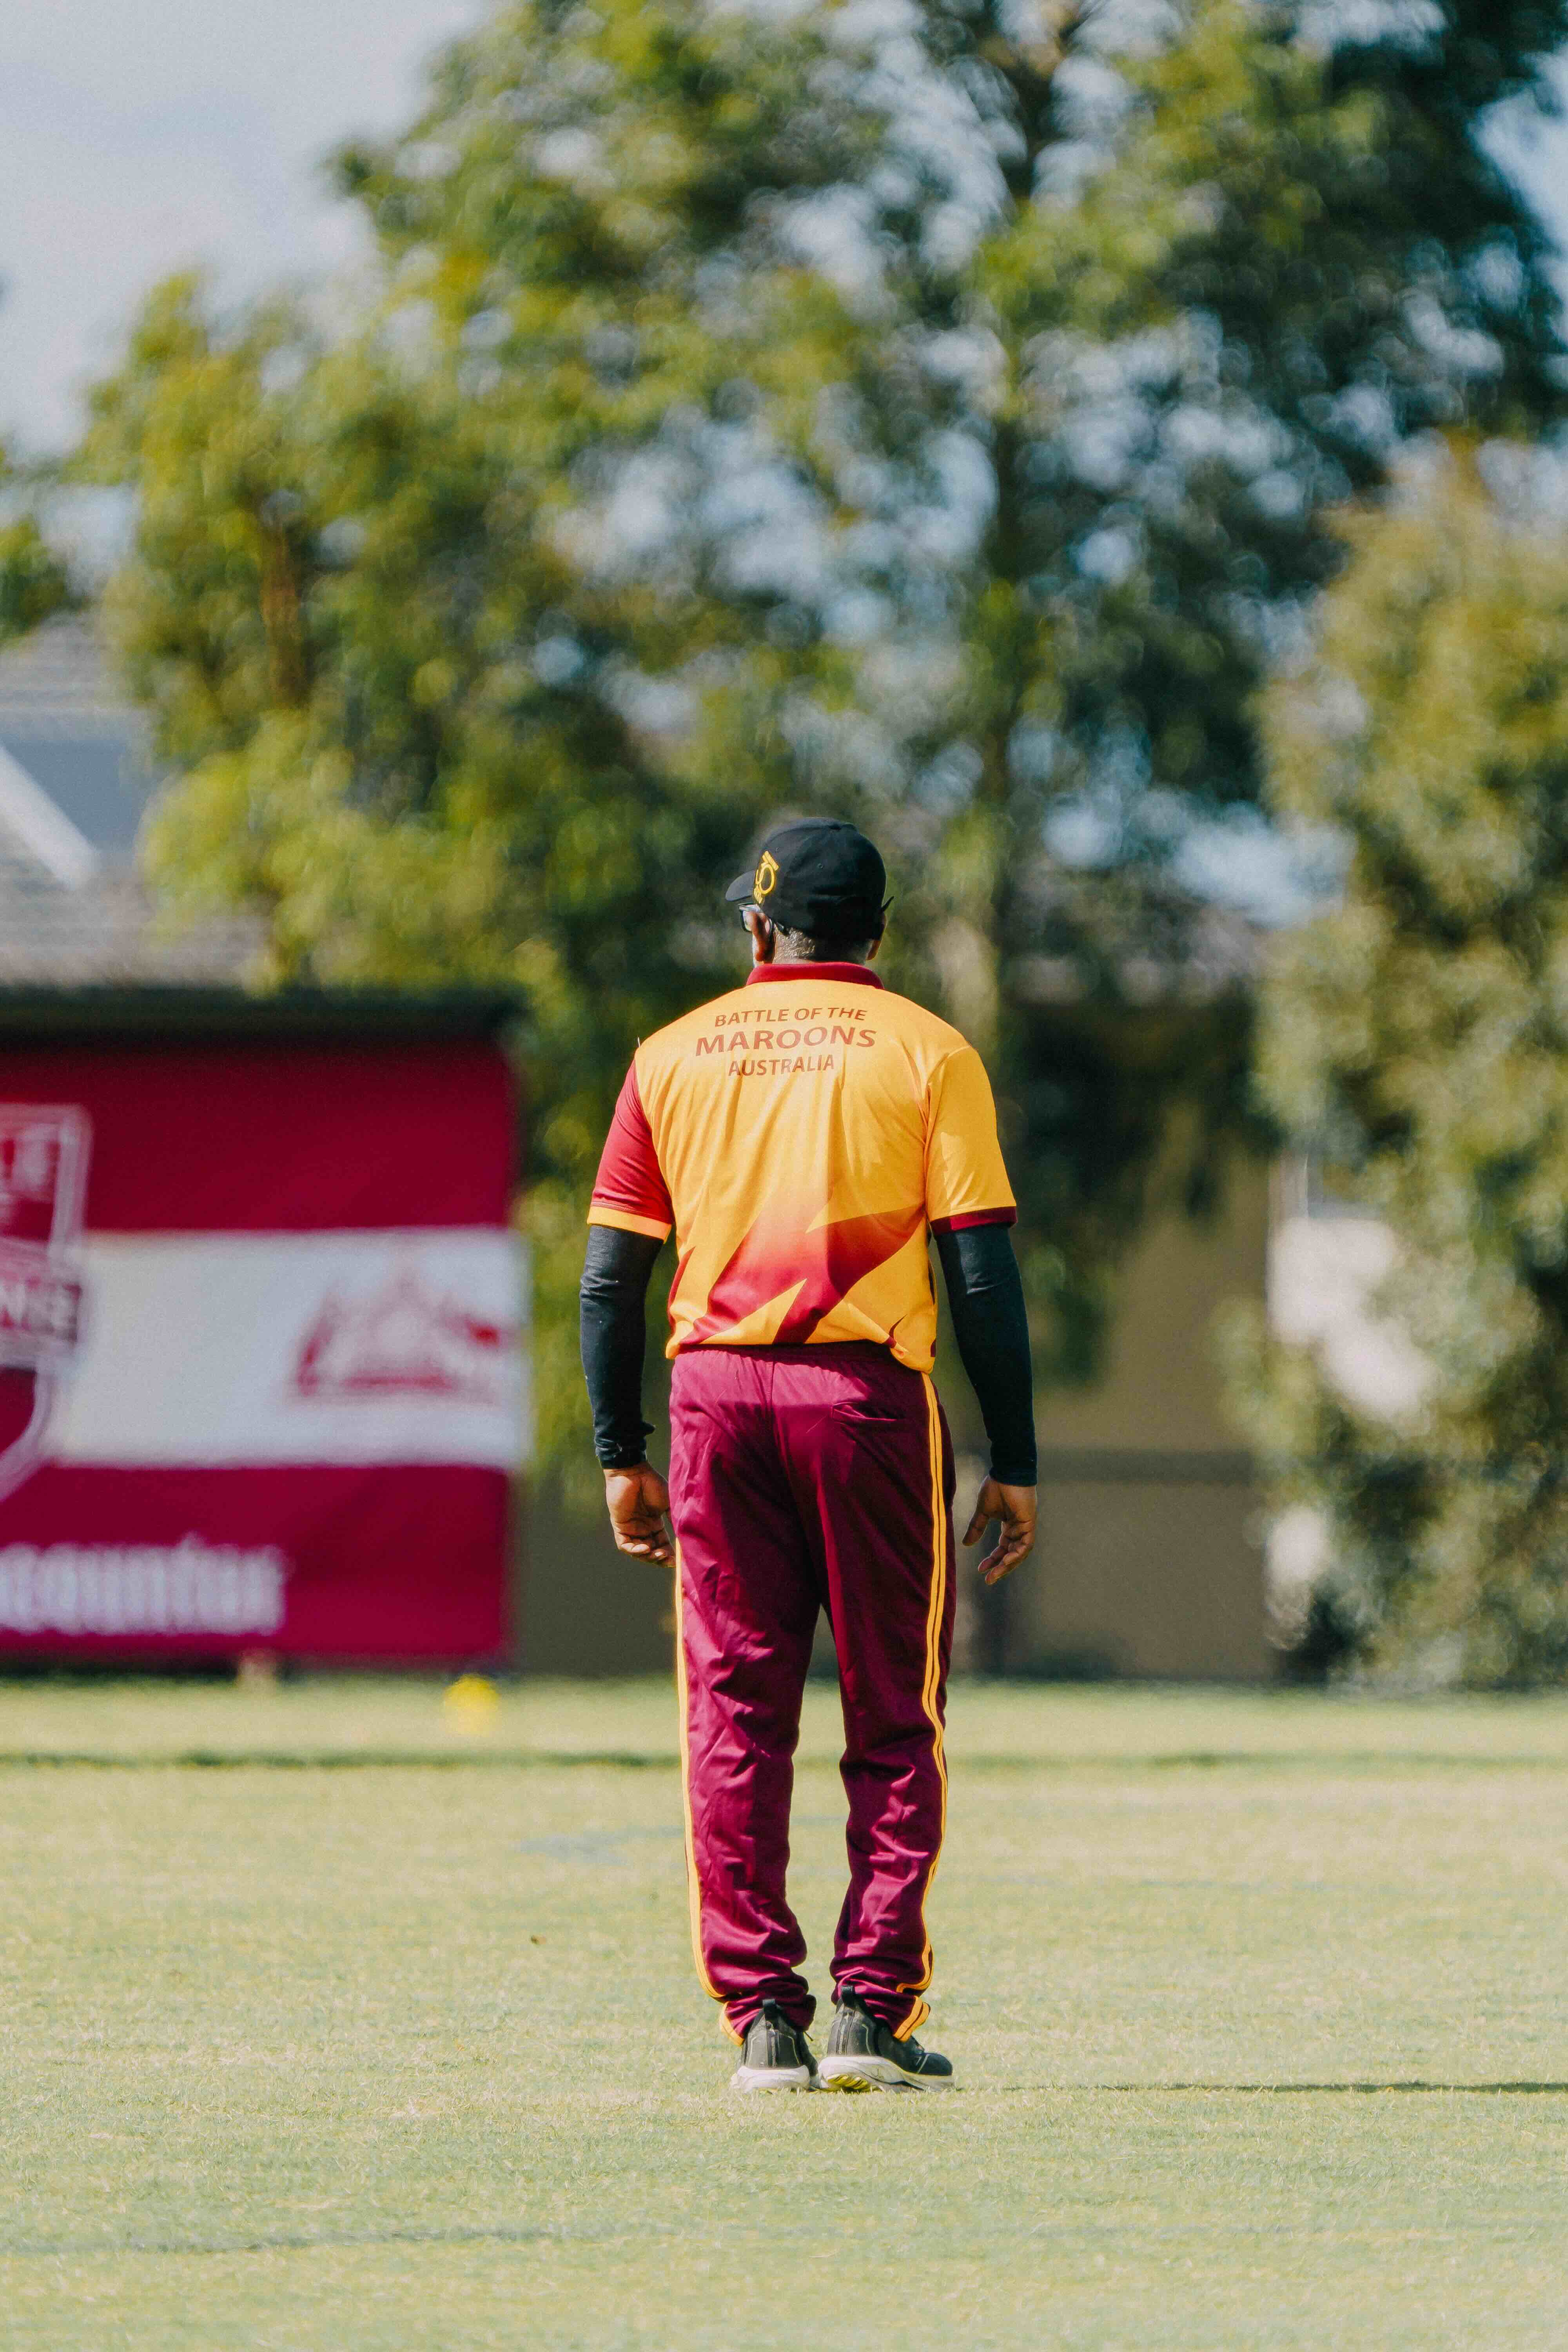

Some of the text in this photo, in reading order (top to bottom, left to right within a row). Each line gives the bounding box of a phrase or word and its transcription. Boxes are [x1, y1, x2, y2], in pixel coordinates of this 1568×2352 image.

[715, 1007, 868, 1027] BATTLE OF THE
[695, 1025, 877, 1056] MAROONS
[728, 1054, 835, 1076] AUSTRALIA
